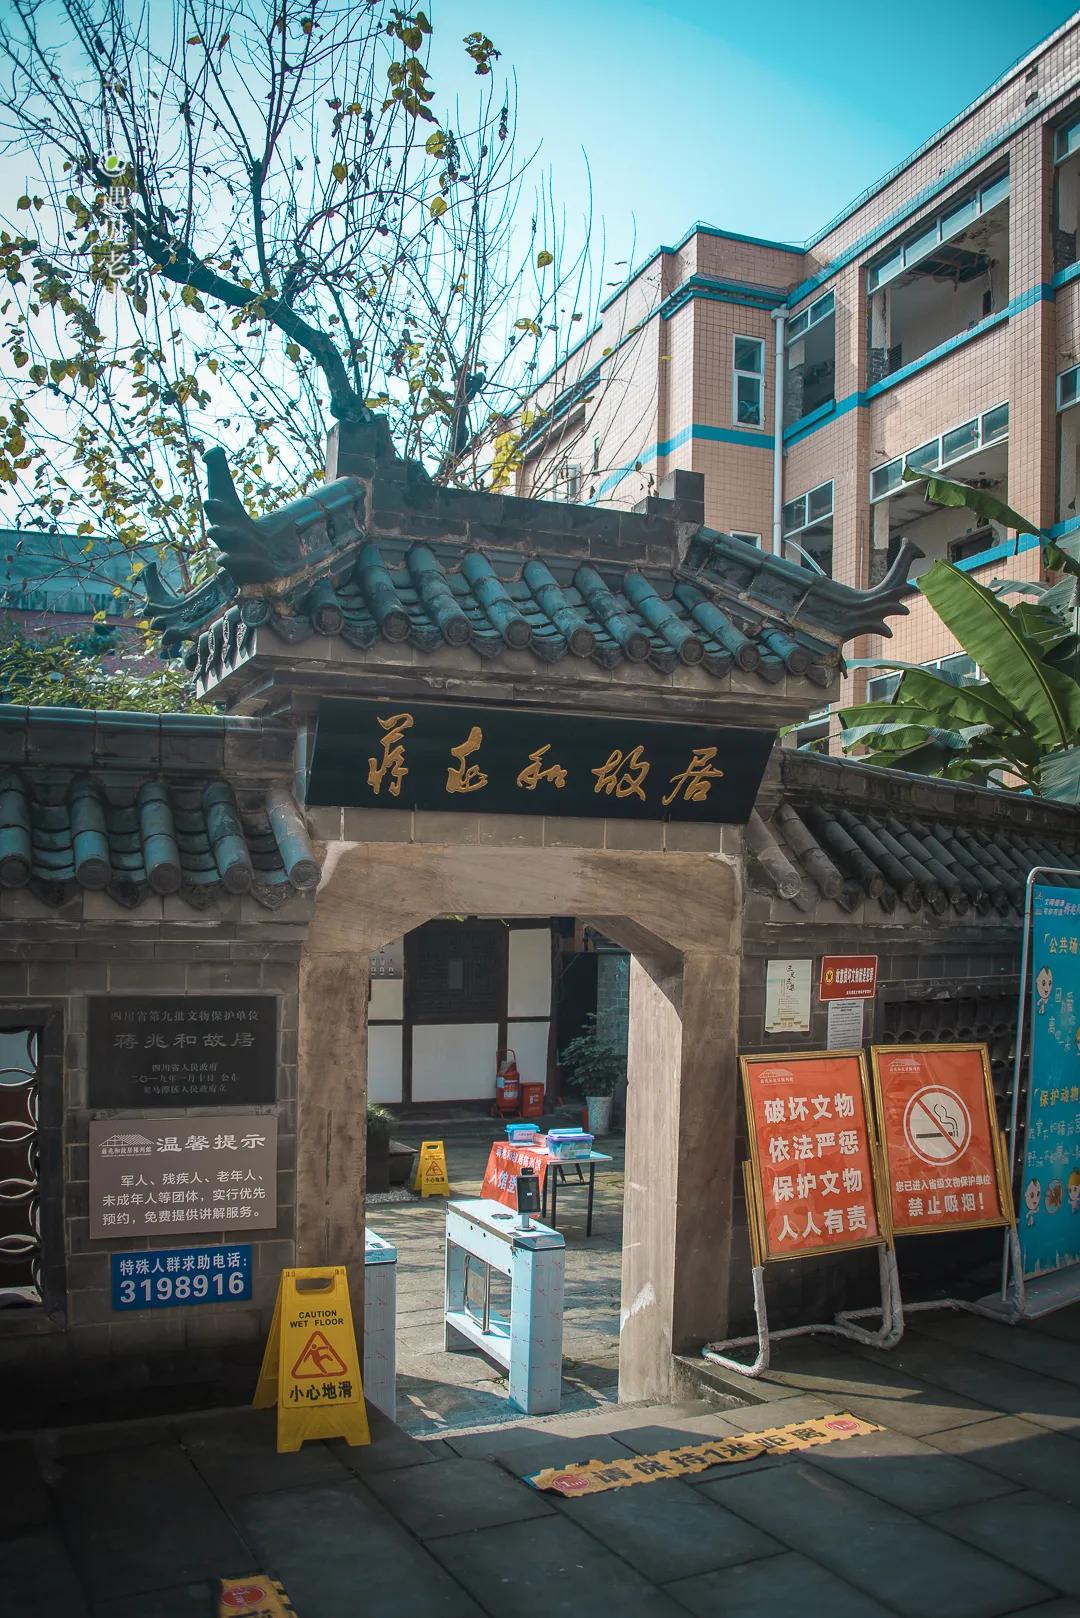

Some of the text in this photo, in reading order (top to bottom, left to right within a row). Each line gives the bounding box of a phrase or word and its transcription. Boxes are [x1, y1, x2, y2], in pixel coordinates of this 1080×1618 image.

[111, 1010, 258, 1021] 四川省第九批文物保护单位
[113, 1032, 255, 1049] 蒋兆和故居
[152, 1062, 217, 1072] 四川省人民政府
[764, 1093, 855, 1123] 破坏文物
[156, 1134, 266, 1152] 温馨提示
[769, 1130, 859, 1163] 依法严惩
[120, 1169, 263, 1187] 军人、残疾人、老年人、
[772, 1167, 863, 1202] 保护文物
[895, 1175, 991, 1192] 您已进入省级文物保护单位
[102, 1187, 266, 1207] 未成年人等团体，实行优先
[102, 1206, 259, 1226] 预约，免费提供讲解服务。
[777, 1205, 868, 1241] 人人有责
[120, 1272, 244, 1303] 3198916
[290, 1318, 344, 1328] WET FLOOR
[299, 1310, 337, 1319] CAUTION
[289, 1381, 353, 1402] 小心地滑
